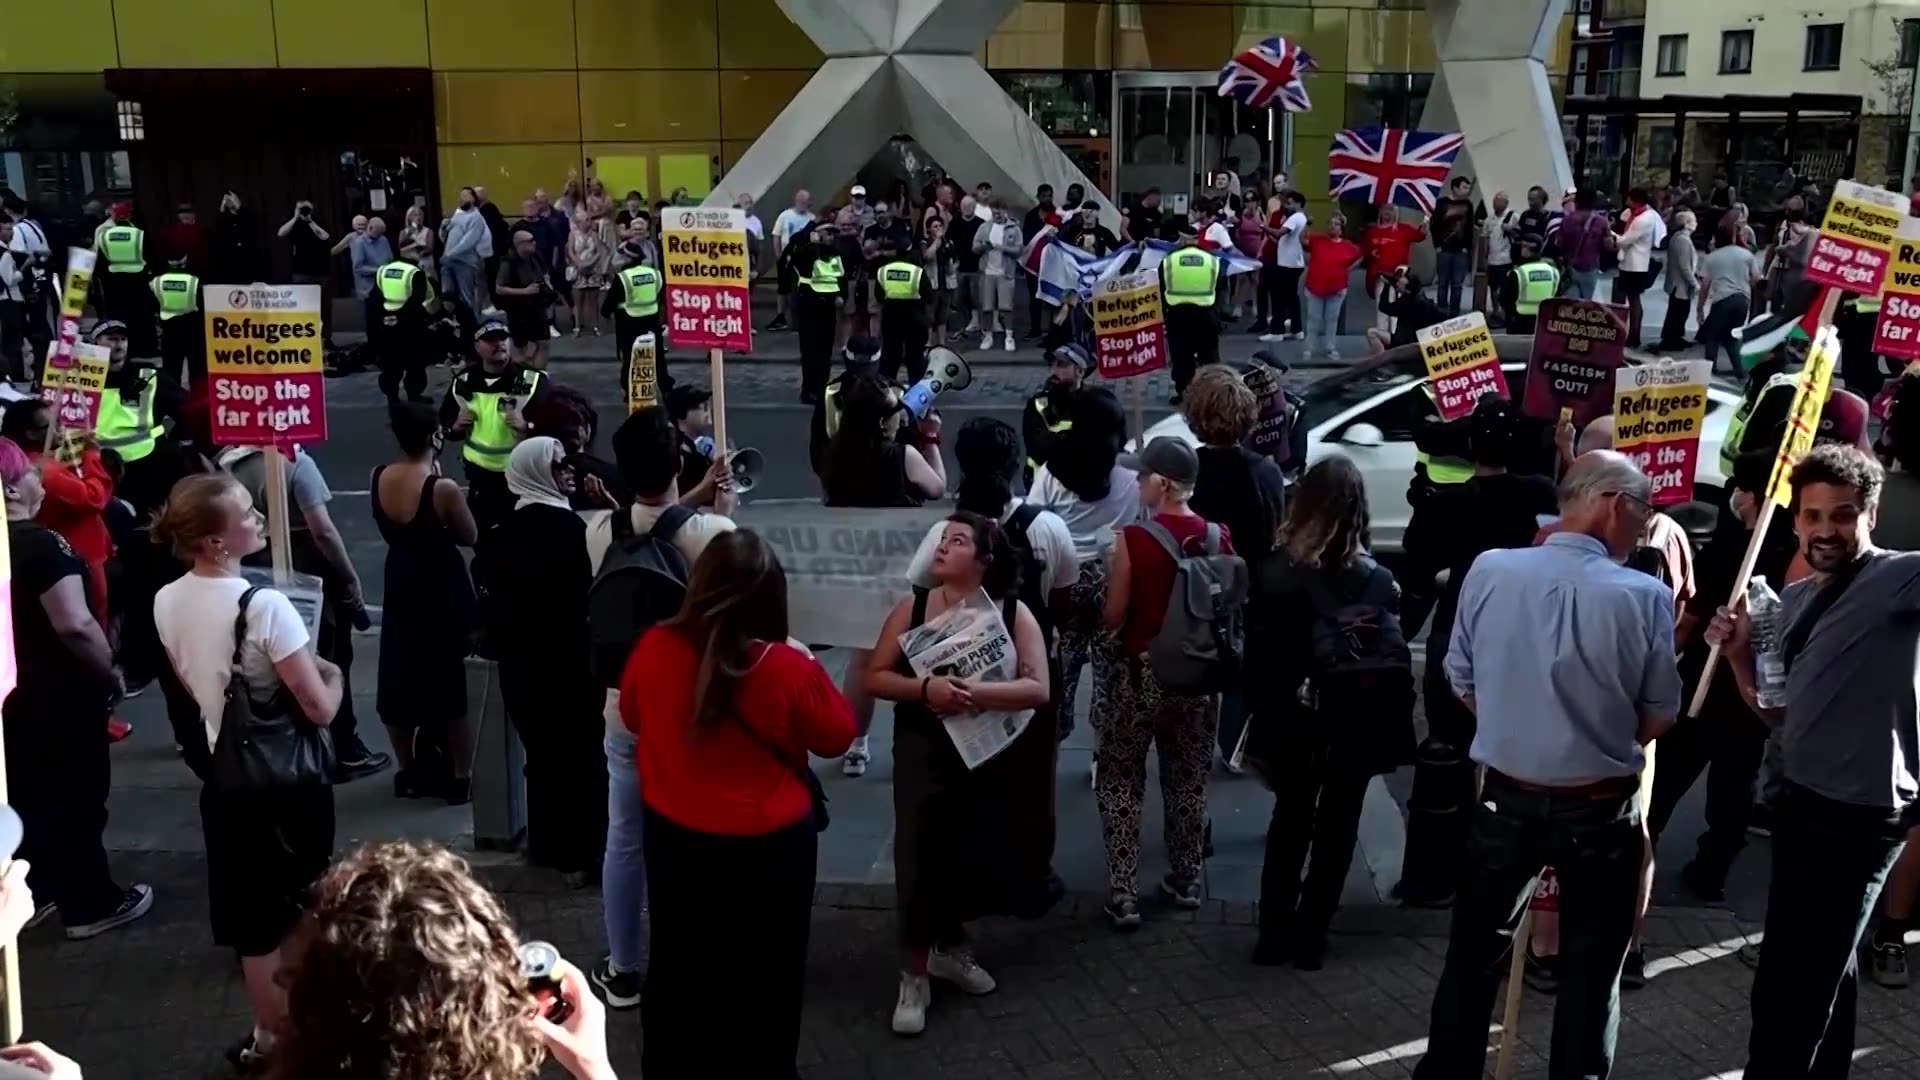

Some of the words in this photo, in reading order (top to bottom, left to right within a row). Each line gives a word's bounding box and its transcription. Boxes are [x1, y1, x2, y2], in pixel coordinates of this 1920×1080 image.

[1832, 200, 1899, 228] Refugees
[1828, 220, 1892, 244] welcome
[668, 236, 744, 260] Refugees
[1818, 238, 1853, 262] Stop
[1855, 250, 1882, 267] the
[670, 260, 743, 278] welcome
[1811, 255, 1836, 273] far
[1836, 264, 1876, 283] right
[672, 289, 712, 314] Stop
[716, 290, 742, 310] the
[1098, 292, 1158, 313] Refugees
[213, 317, 316, 344] Refugees
[674, 312, 699, 331] far
[704, 314, 743, 338] right
[1099, 309, 1157, 329] welcome
[1882, 320, 1913, 340] far
[1100, 337, 1134, 351] Stop
[1137, 331, 1157, 346] the
[1426, 332, 1488, 358] Refugees
[214, 345, 312, 365] welcome
[1102, 354, 1123, 368] far
[1127, 345, 1157, 366] right
[1432, 348, 1489, 372] welcome
[1436, 375, 1470, 394] Stop
[1470, 368, 1495, 383] the
[1543, 360, 1606, 380] FASCISM
[216, 378, 268, 406] Stop
[274, 378, 311, 400] the
[1554, 378, 1589, 394] OUT!
[1442, 394, 1463, 408] far
[1620, 392, 1702, 416] Refugees
[217, 404, 250, 426] far
[257, 404, 311, 432] right
[1618, 417, 1694, 440] welcome
[1657, 446, 1686, 465] the
[1648, 469, 1683, 493] ight
[969, 634, 1008, 661] PUSHES
